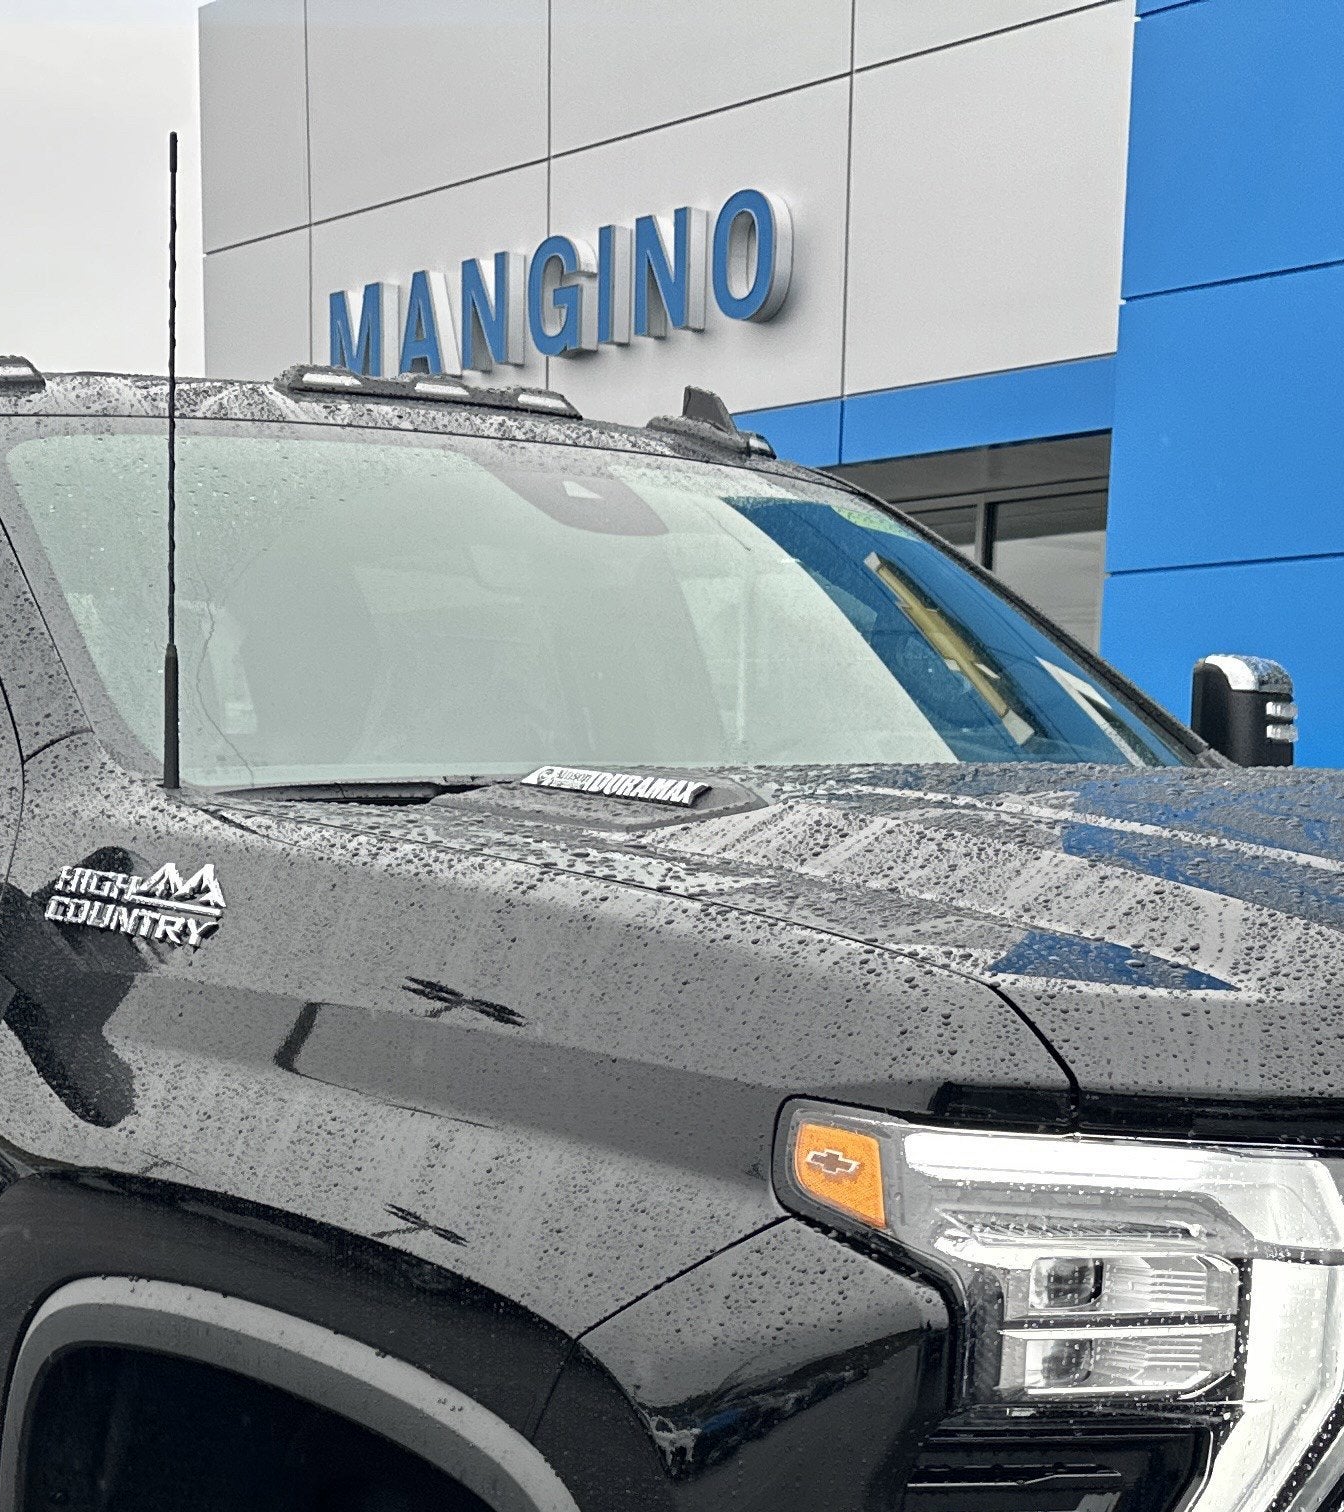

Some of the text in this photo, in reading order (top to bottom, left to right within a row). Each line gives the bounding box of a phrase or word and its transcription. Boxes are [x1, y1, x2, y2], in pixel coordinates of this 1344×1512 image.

[329, 189, 791, 378] MANGINO
[589, 771, 710, 804] DURAMAX
[55, 865, 143, 900] HIGH
[44, 894, 220, 946] COUNTRY
